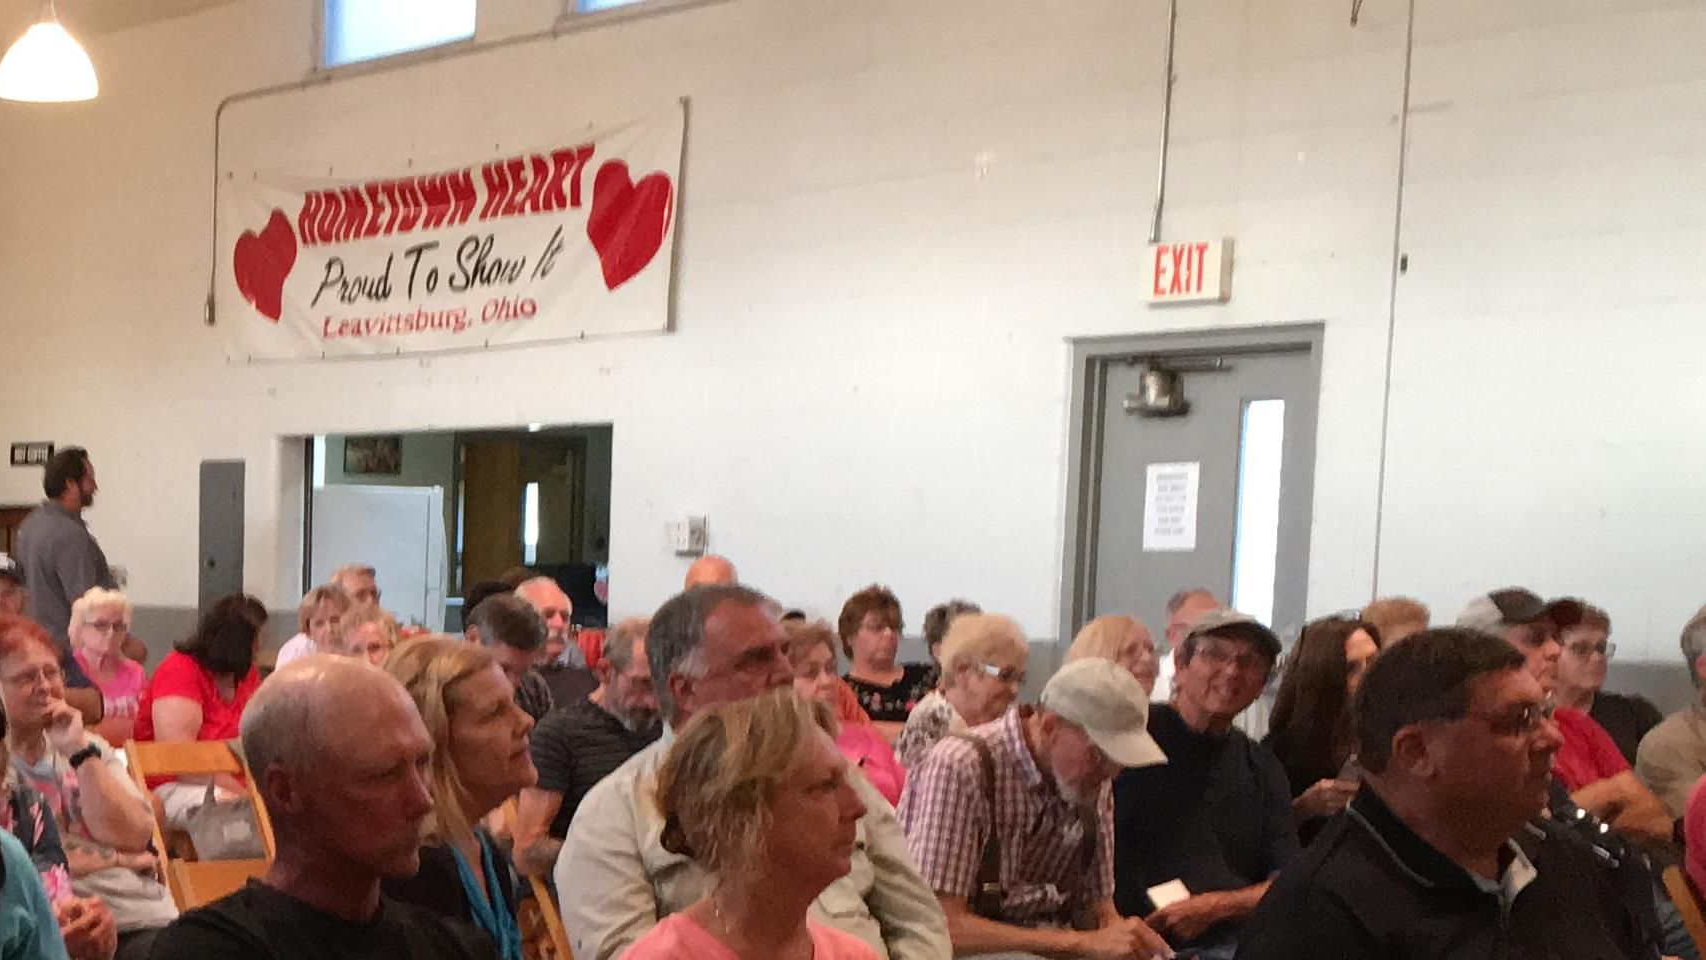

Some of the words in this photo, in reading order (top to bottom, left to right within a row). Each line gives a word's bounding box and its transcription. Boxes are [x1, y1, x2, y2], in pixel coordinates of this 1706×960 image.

[298, 167, 478, 248] HOMETOWN
[478, 142, 595, 221] HEART
[311, 251, 393, 308] Proud
[404, 240, 440, 300] To
[449, 233, 526, 293] Show
[530, 224, 564, 283] It
[1153, 242, 1209, 297] EXIT
[323, 305, 473, 339] Leavittsburg,
[481, 293, 537, 326] Ohio
